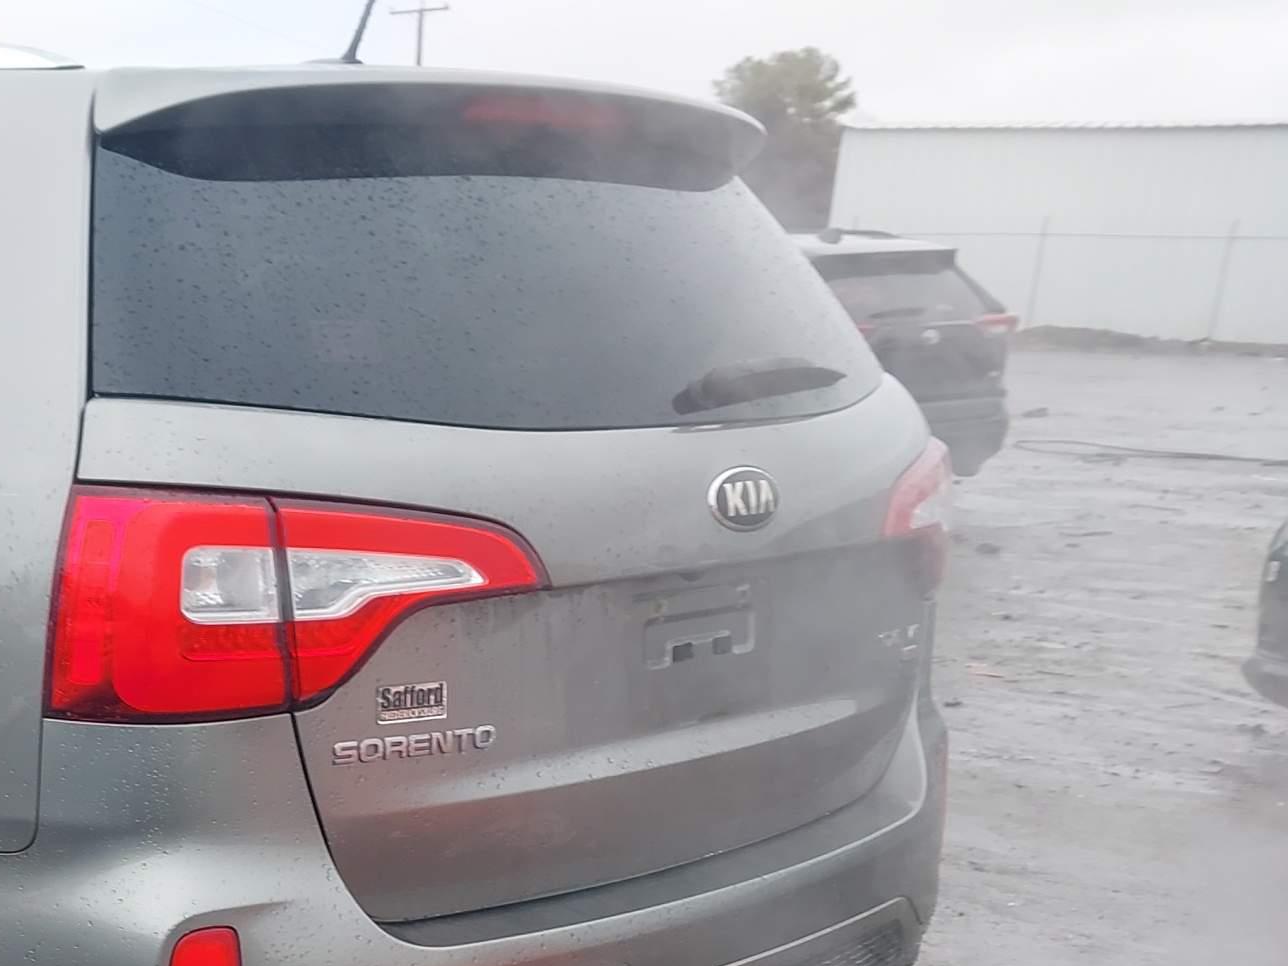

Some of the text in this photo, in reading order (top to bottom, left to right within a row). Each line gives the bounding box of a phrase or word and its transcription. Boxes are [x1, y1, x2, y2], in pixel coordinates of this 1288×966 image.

[722, 479, 776, 517] KIA
[380, 683, 444, 709] Safford
[333, 724, 496, 765] SORENTO
